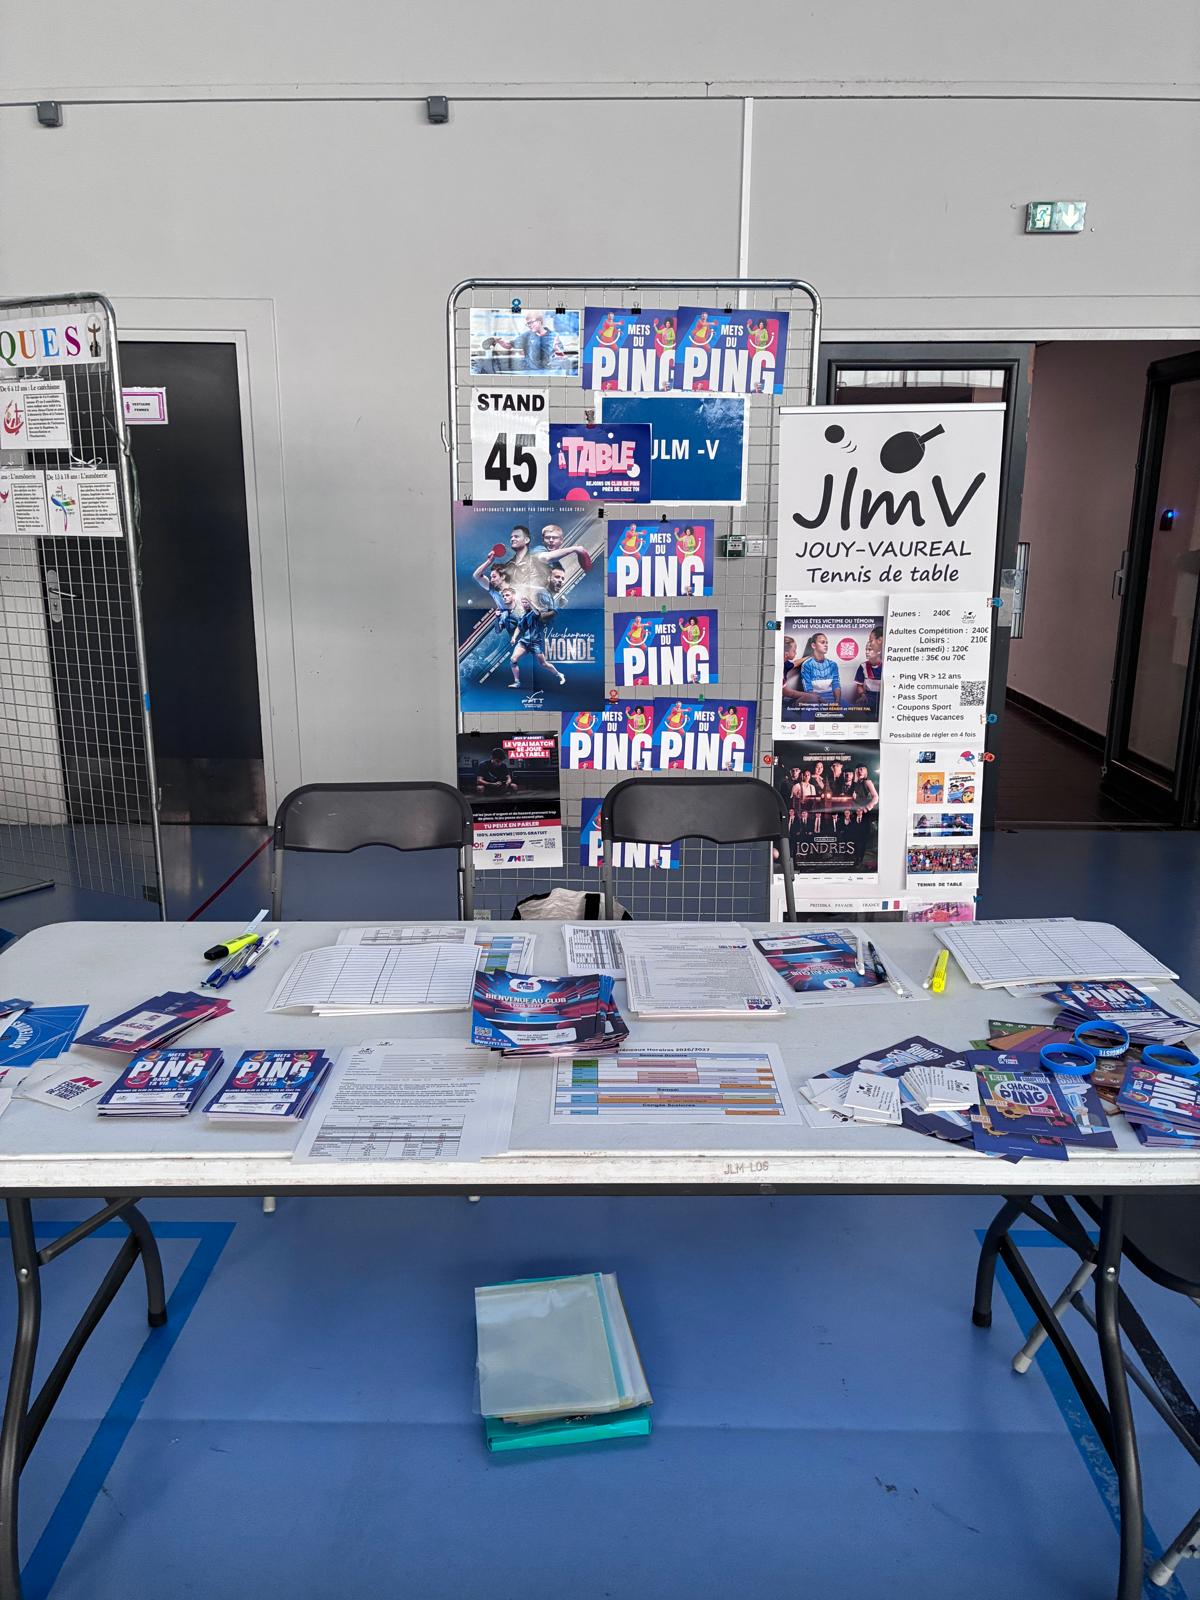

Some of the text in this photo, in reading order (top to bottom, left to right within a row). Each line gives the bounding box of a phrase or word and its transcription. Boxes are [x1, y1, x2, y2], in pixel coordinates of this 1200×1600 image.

[627, 324, 651, 336] METS
[720, 324, 744, 336] METS
[633, 336, 644, 347] DU
[725, 336, 737, 348] DU
[683, 347, 776, 394] PING
[477, 393, 545, 412] STAND
[651, 439, 690, 460] JLM
[484, 432, 537, 493] 45
[561, 436, 636, 477] TABLE
[650, 533, 672, 544] METS
[655, 544, 666, 555] DU
[796, 541, 971, 558] JOUY-VAUREAL
[616, 555, 705, 597] PING
[806, 564, 960, 583] Tennis de table
[654, 623, 676, 635] METS
[918, 627, 964, 636] Compétition
[660, 635, 671, 646] DU
[970, 636, 988, 644] 210€
[544, 638, 595, 660] MONDE
[913, 646, 945, 654] (samedi)
[623, 645, 710, 687] PING
[917, 693, 938, 701] Sport
[602, 711, 623, 722] METS
[694, 711, 716, 722] METS
[896, 714, 928, 722] Chèques
[607, 722, 617, 731] DU
[699, 722, 710, 731] DU
[569, 732, 653, 771] PING
[659, 731, 746, 772] PING
[796, 841, 855, 855] LONDRES
[485, 993, 529, 1003] BIENVENUE
[1071, 988, 1141, 1003] PING
[128, 1060, 206, 1078] PING
[236, 1061, 312, 1078] PING
[1008, 1082, 1039, 1092] CHACUN
[999, 1089, 1045, 1105] PING
